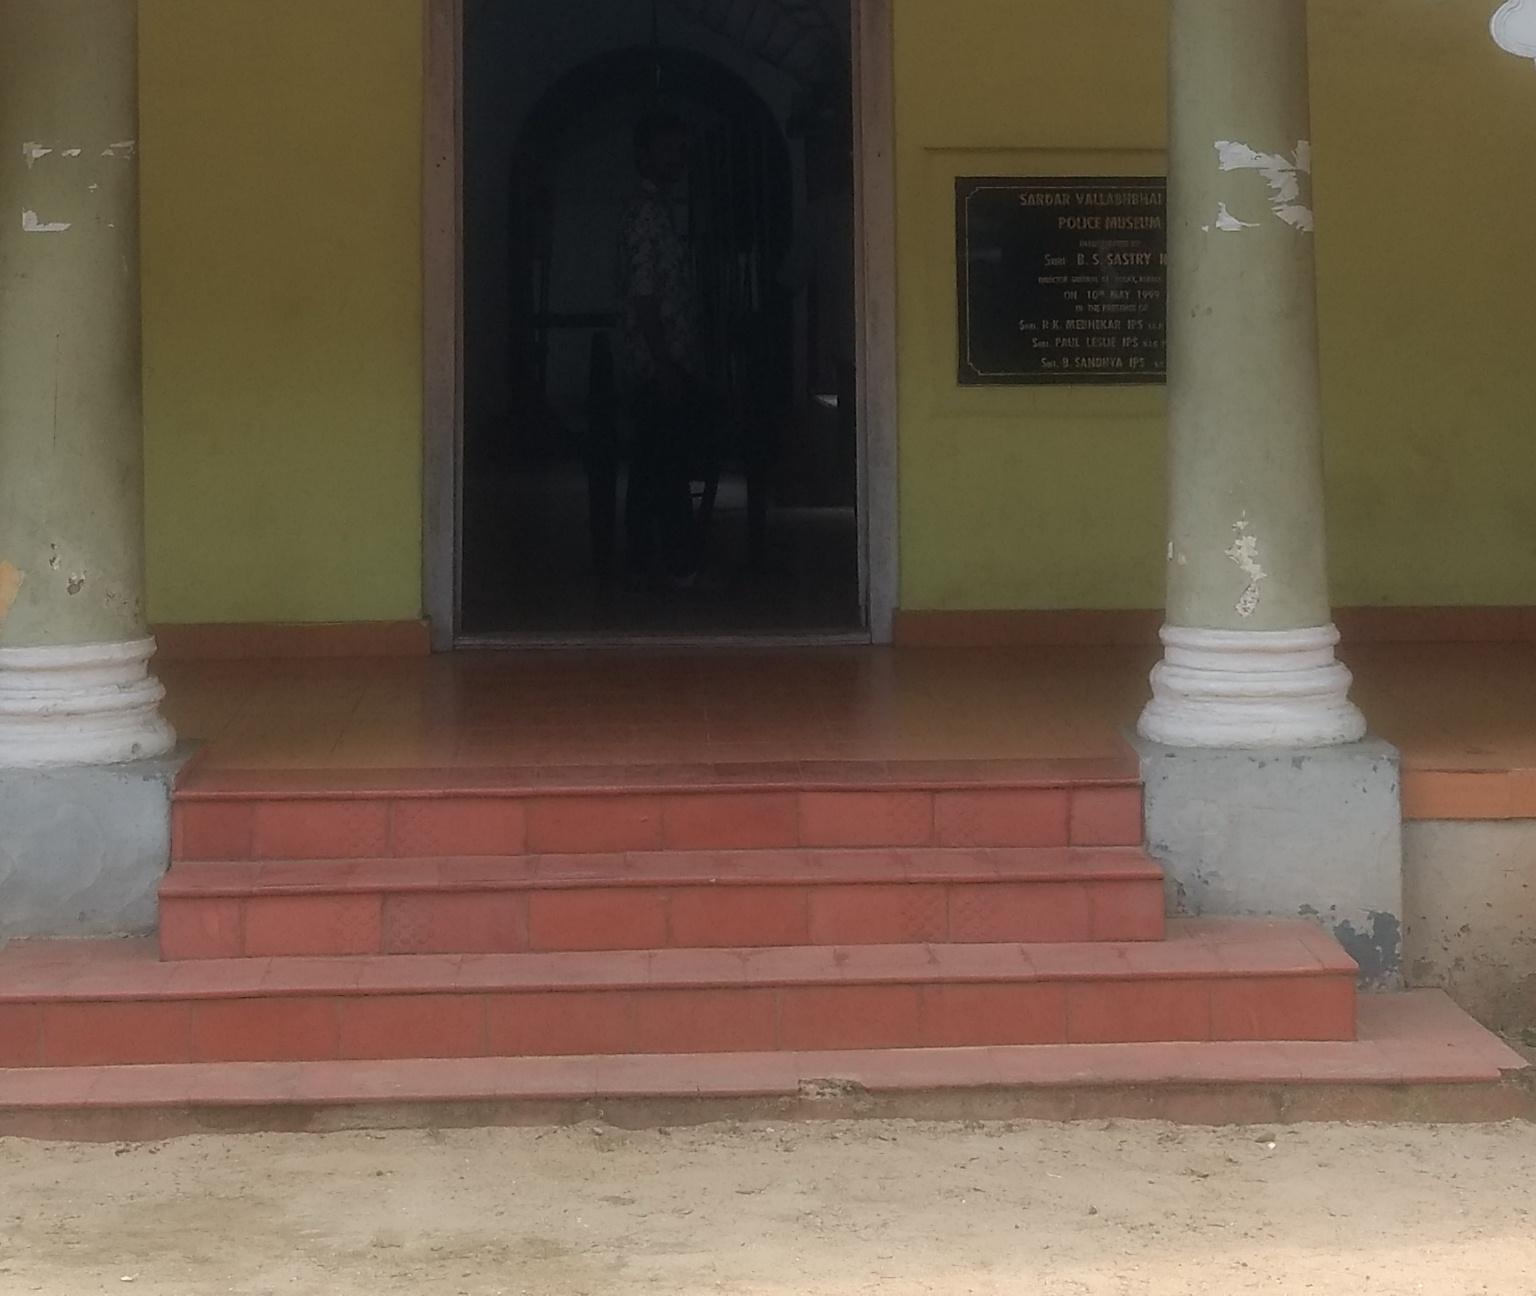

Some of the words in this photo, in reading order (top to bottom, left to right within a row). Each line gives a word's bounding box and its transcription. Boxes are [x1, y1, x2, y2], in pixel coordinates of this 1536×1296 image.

[1019, 192, 1072, 206] SARDAR
[1058, 216, 1102, 230] POLICE
[1105, 216, 1161, 230] MUSEUM
[1107, 253, 1152, 266] SASTRY
[1127, 319, 1144, 330] IPS
[1122, 337, 1138, 348] IPS
[1128, 357, 1144, 369] IPS
